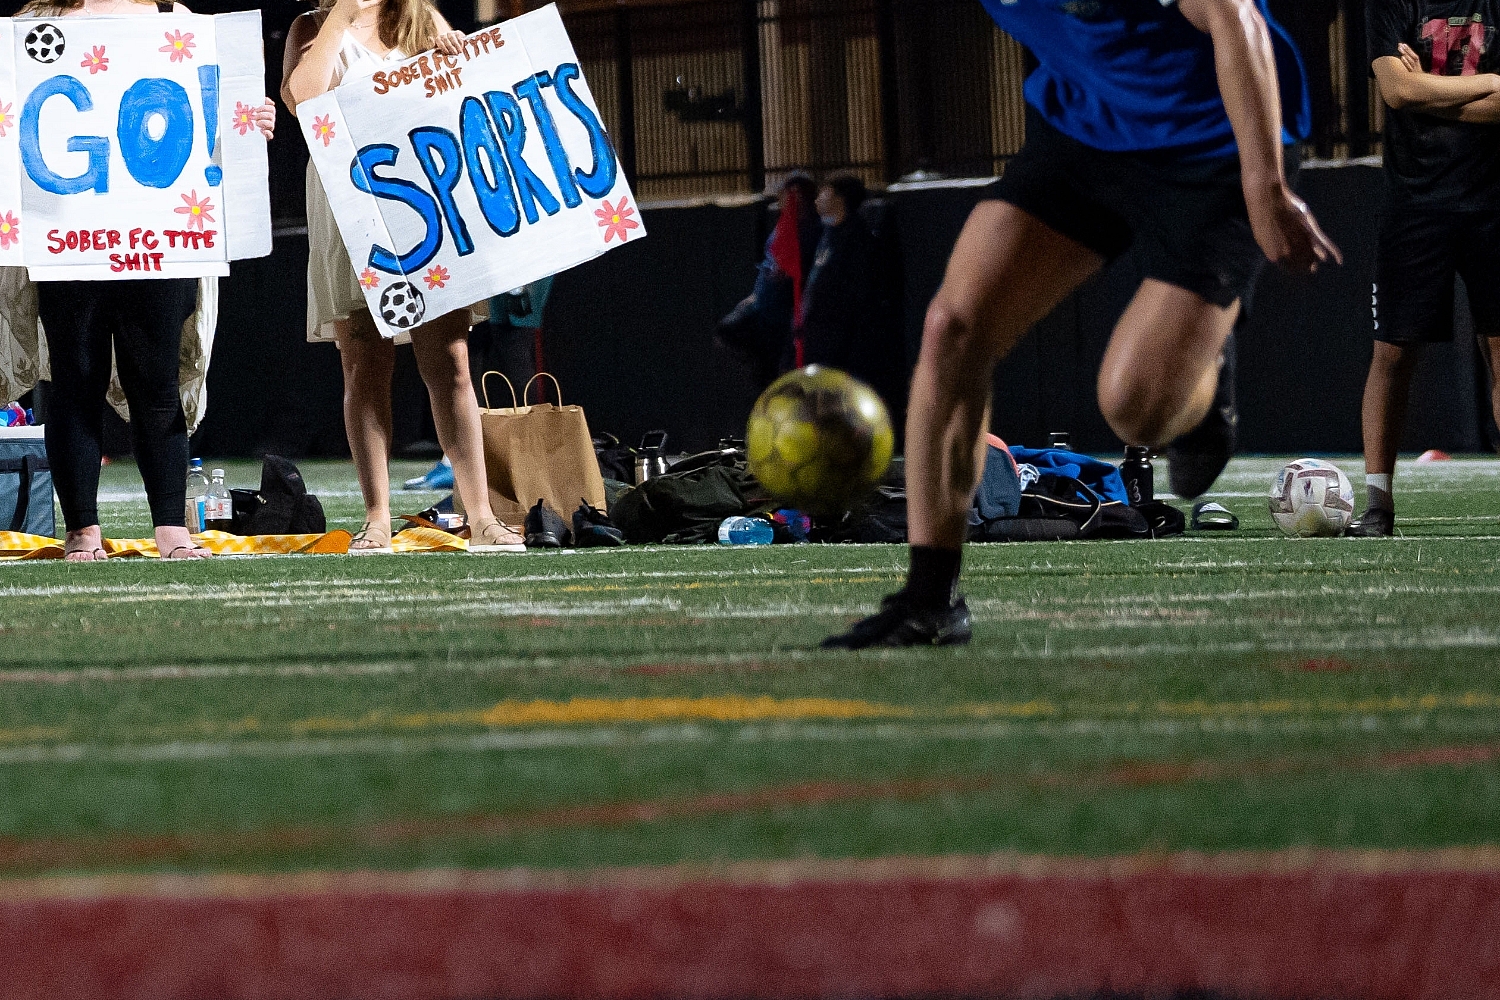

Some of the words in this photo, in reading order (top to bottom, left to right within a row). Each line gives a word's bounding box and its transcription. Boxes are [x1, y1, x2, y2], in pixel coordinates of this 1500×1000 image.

[372, 55, 433, 95] SOBER
[431, 48, 458, 72] FC
[462, 27, 505, 62] TYPE
[423, 67, 463, 98] SHIT
[19, 64, 223, 196] GO!
[350, 63, 618, 276] SPORTS
[47, 229, 121, 254] SOBER
[129, 227, 160, 250] FC
[163, 230, 218, 250] TYPE
[109, 252, 164, 272] SHIT
